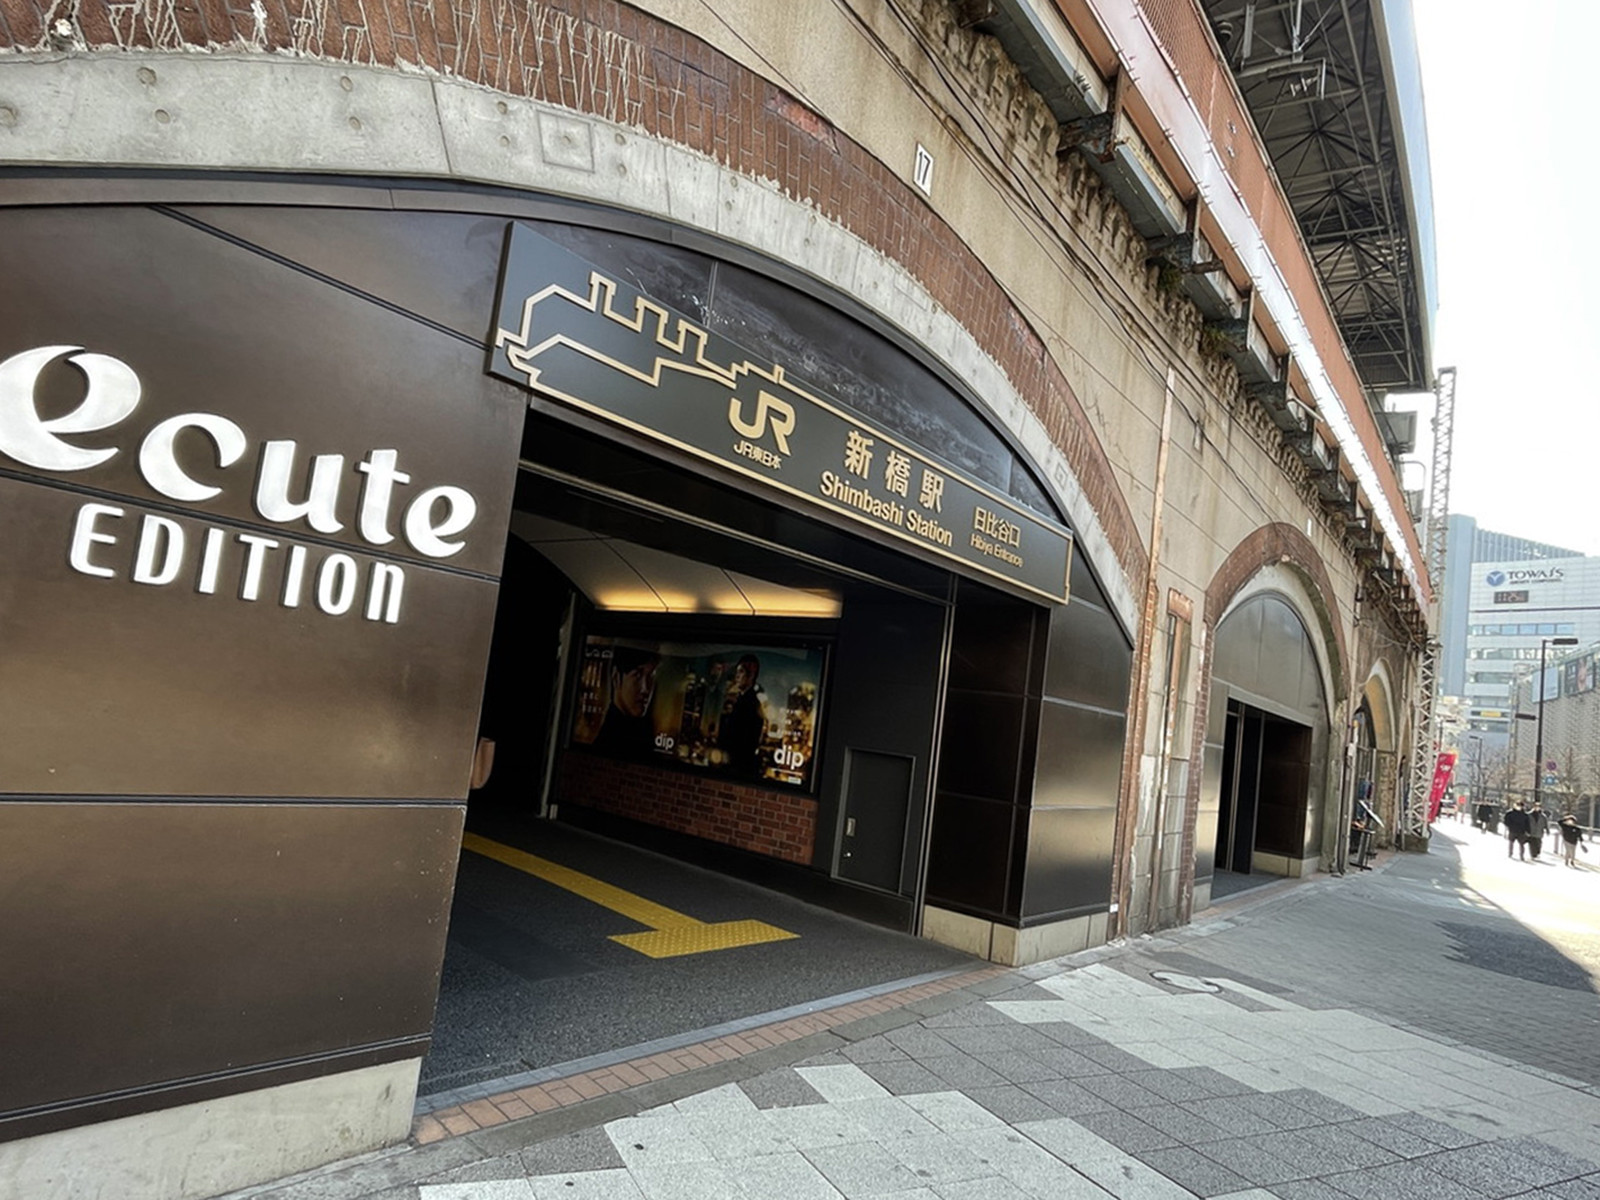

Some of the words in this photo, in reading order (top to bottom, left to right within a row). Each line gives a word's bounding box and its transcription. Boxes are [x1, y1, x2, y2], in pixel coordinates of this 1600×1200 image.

[918, 150, 931, 186] 17
[728, 389, 796, 456] JR
[0, 345, 477, 558] ecute
[733, 440, 782, 470] JR東日本
[844, 430, 946, 513] 新橋駅
[819, 470, 904, 526] Shimbashi
[906, 509, 953, 547] Station
[974, 506, 1021, 548] 日比谷口
[970, 533, 993, 556] Hibiya
[994, 543, 1024, 568] Entrance
[654, 733, 675, 750] dip
[773, 745, 804, 769] dip
